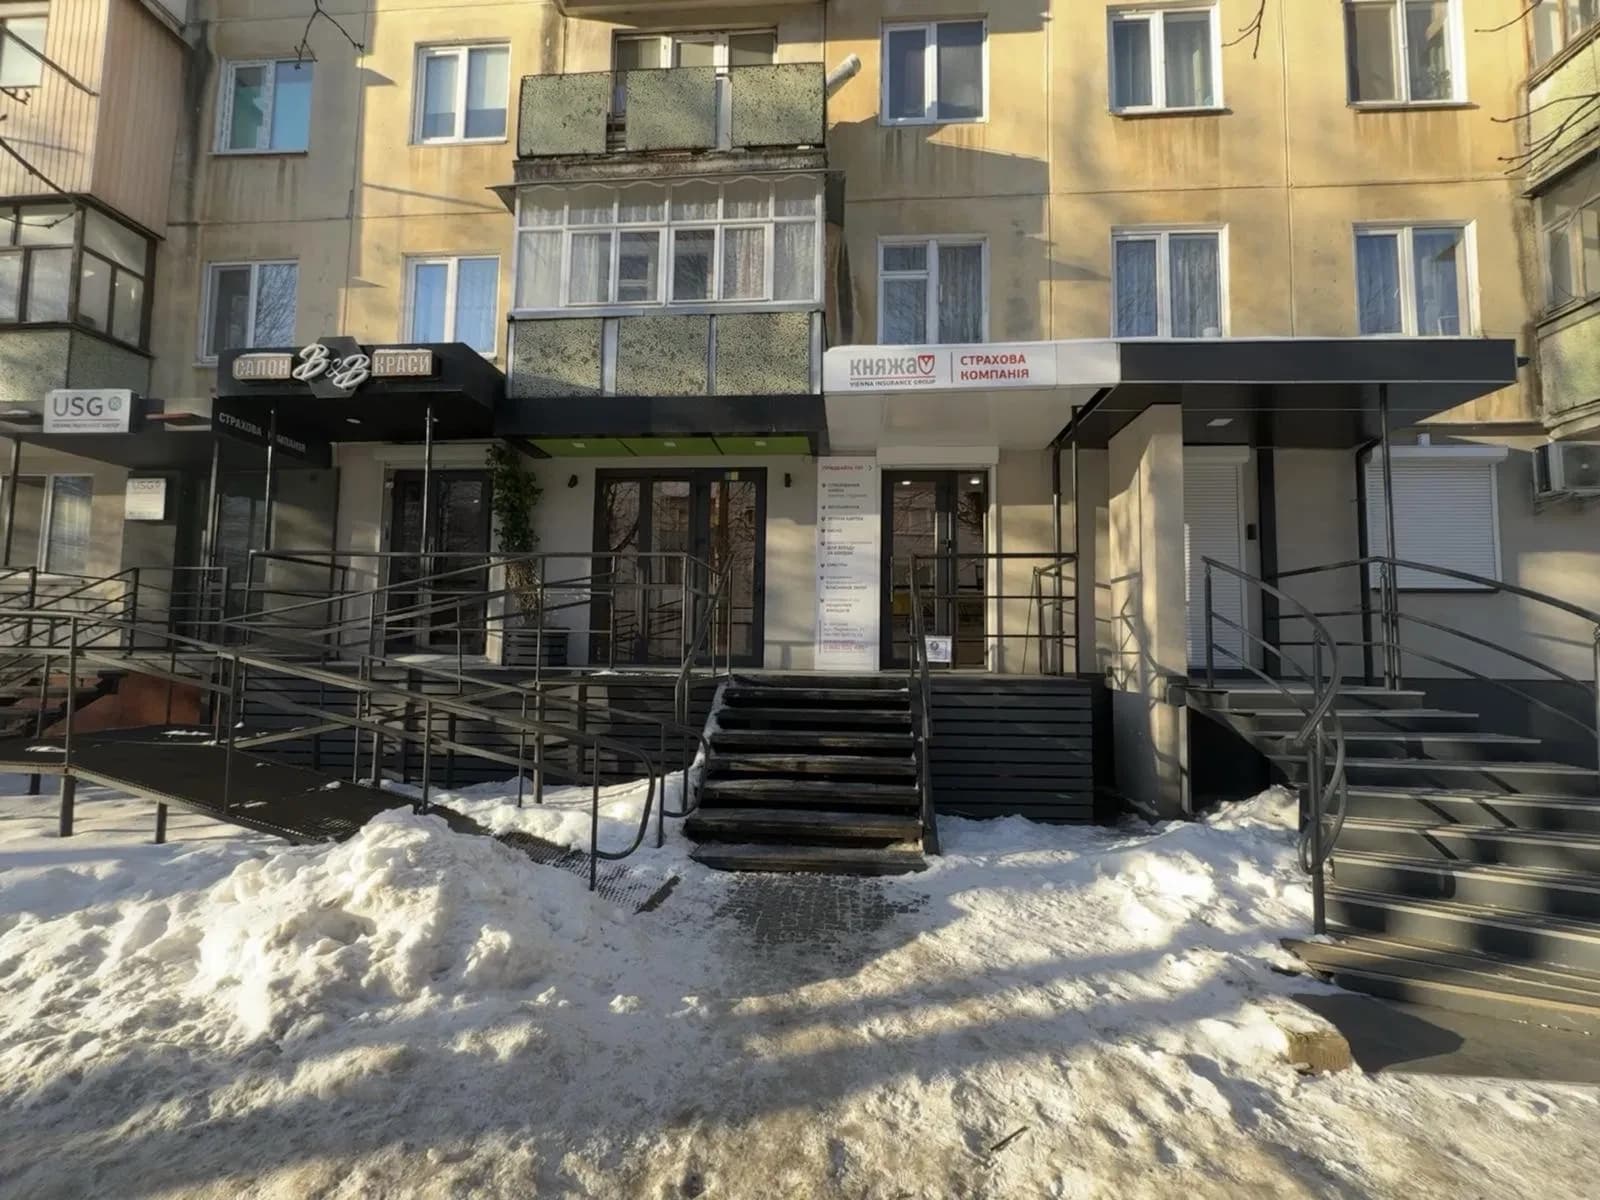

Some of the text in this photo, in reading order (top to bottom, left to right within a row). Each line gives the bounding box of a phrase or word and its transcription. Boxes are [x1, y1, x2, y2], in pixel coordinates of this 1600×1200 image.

[234, 359, 289, 378] САЛОН
[374, 354, 430, 374] КРАСИ
[960, 354, 1026, 366] СТРАХОВА
[960, 368, 1030, 381] КОМПАНІЯ
[53, 396, 104, 417] USG
[218, 411, 263, 437] СТРАХОВА
